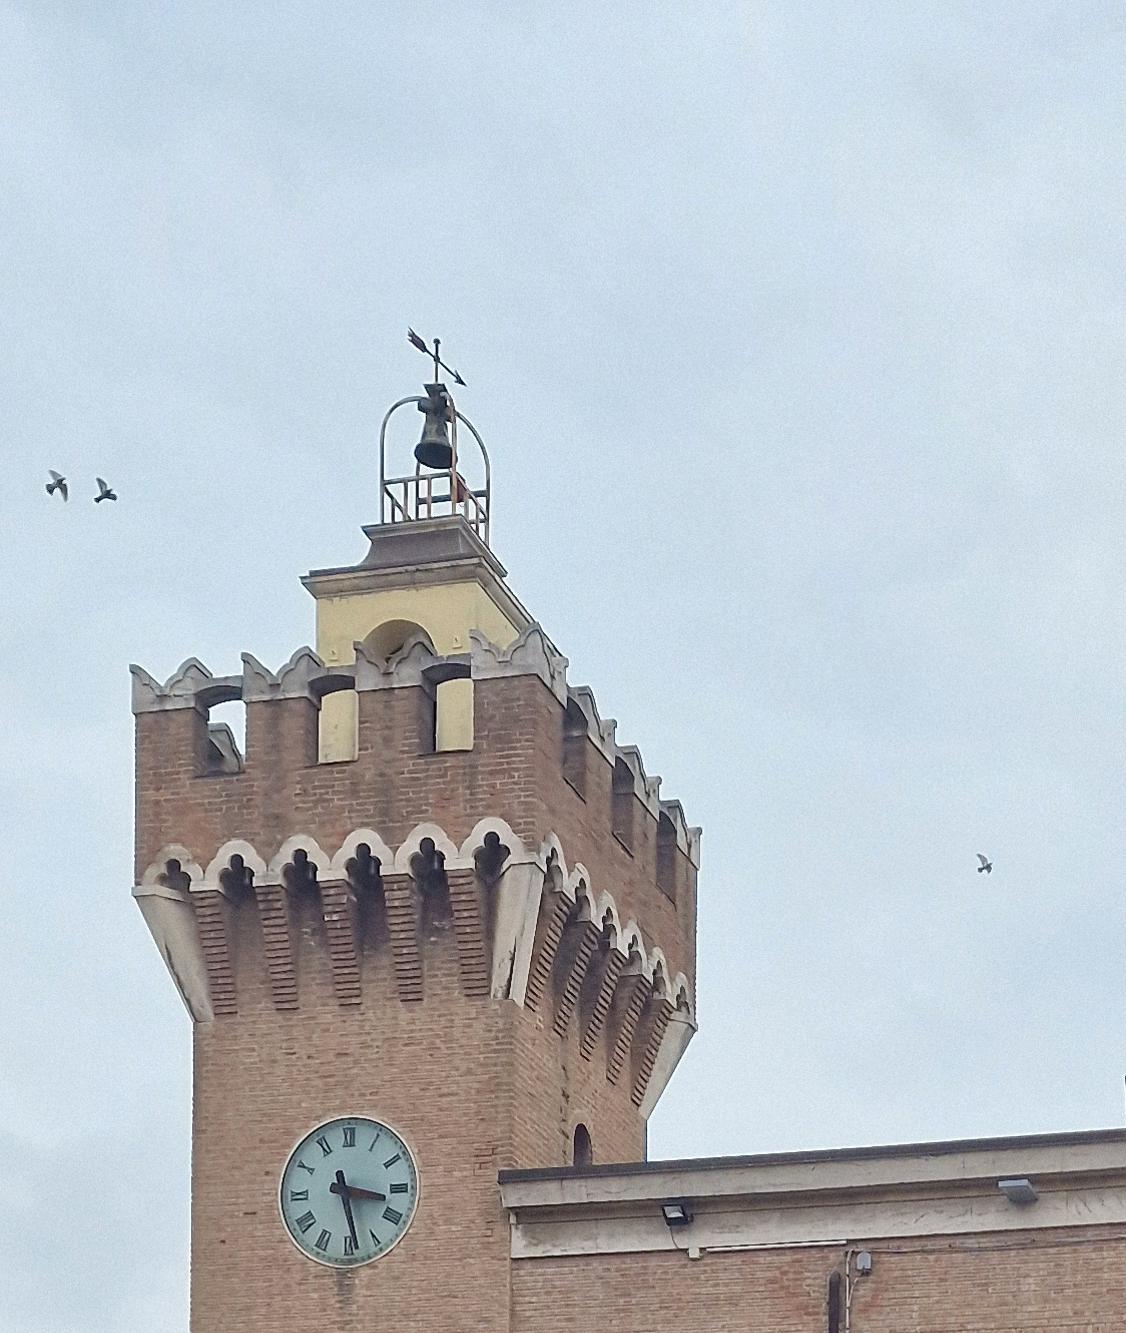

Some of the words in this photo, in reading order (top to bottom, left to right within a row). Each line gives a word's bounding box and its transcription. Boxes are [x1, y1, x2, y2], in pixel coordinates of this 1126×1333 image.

[315, 1135, 333, 1157] XI
[342, 1127, 356, 1148] XII
[290, 1189, 309, 1202] IX
[389, 1182, 409, 1194] III
